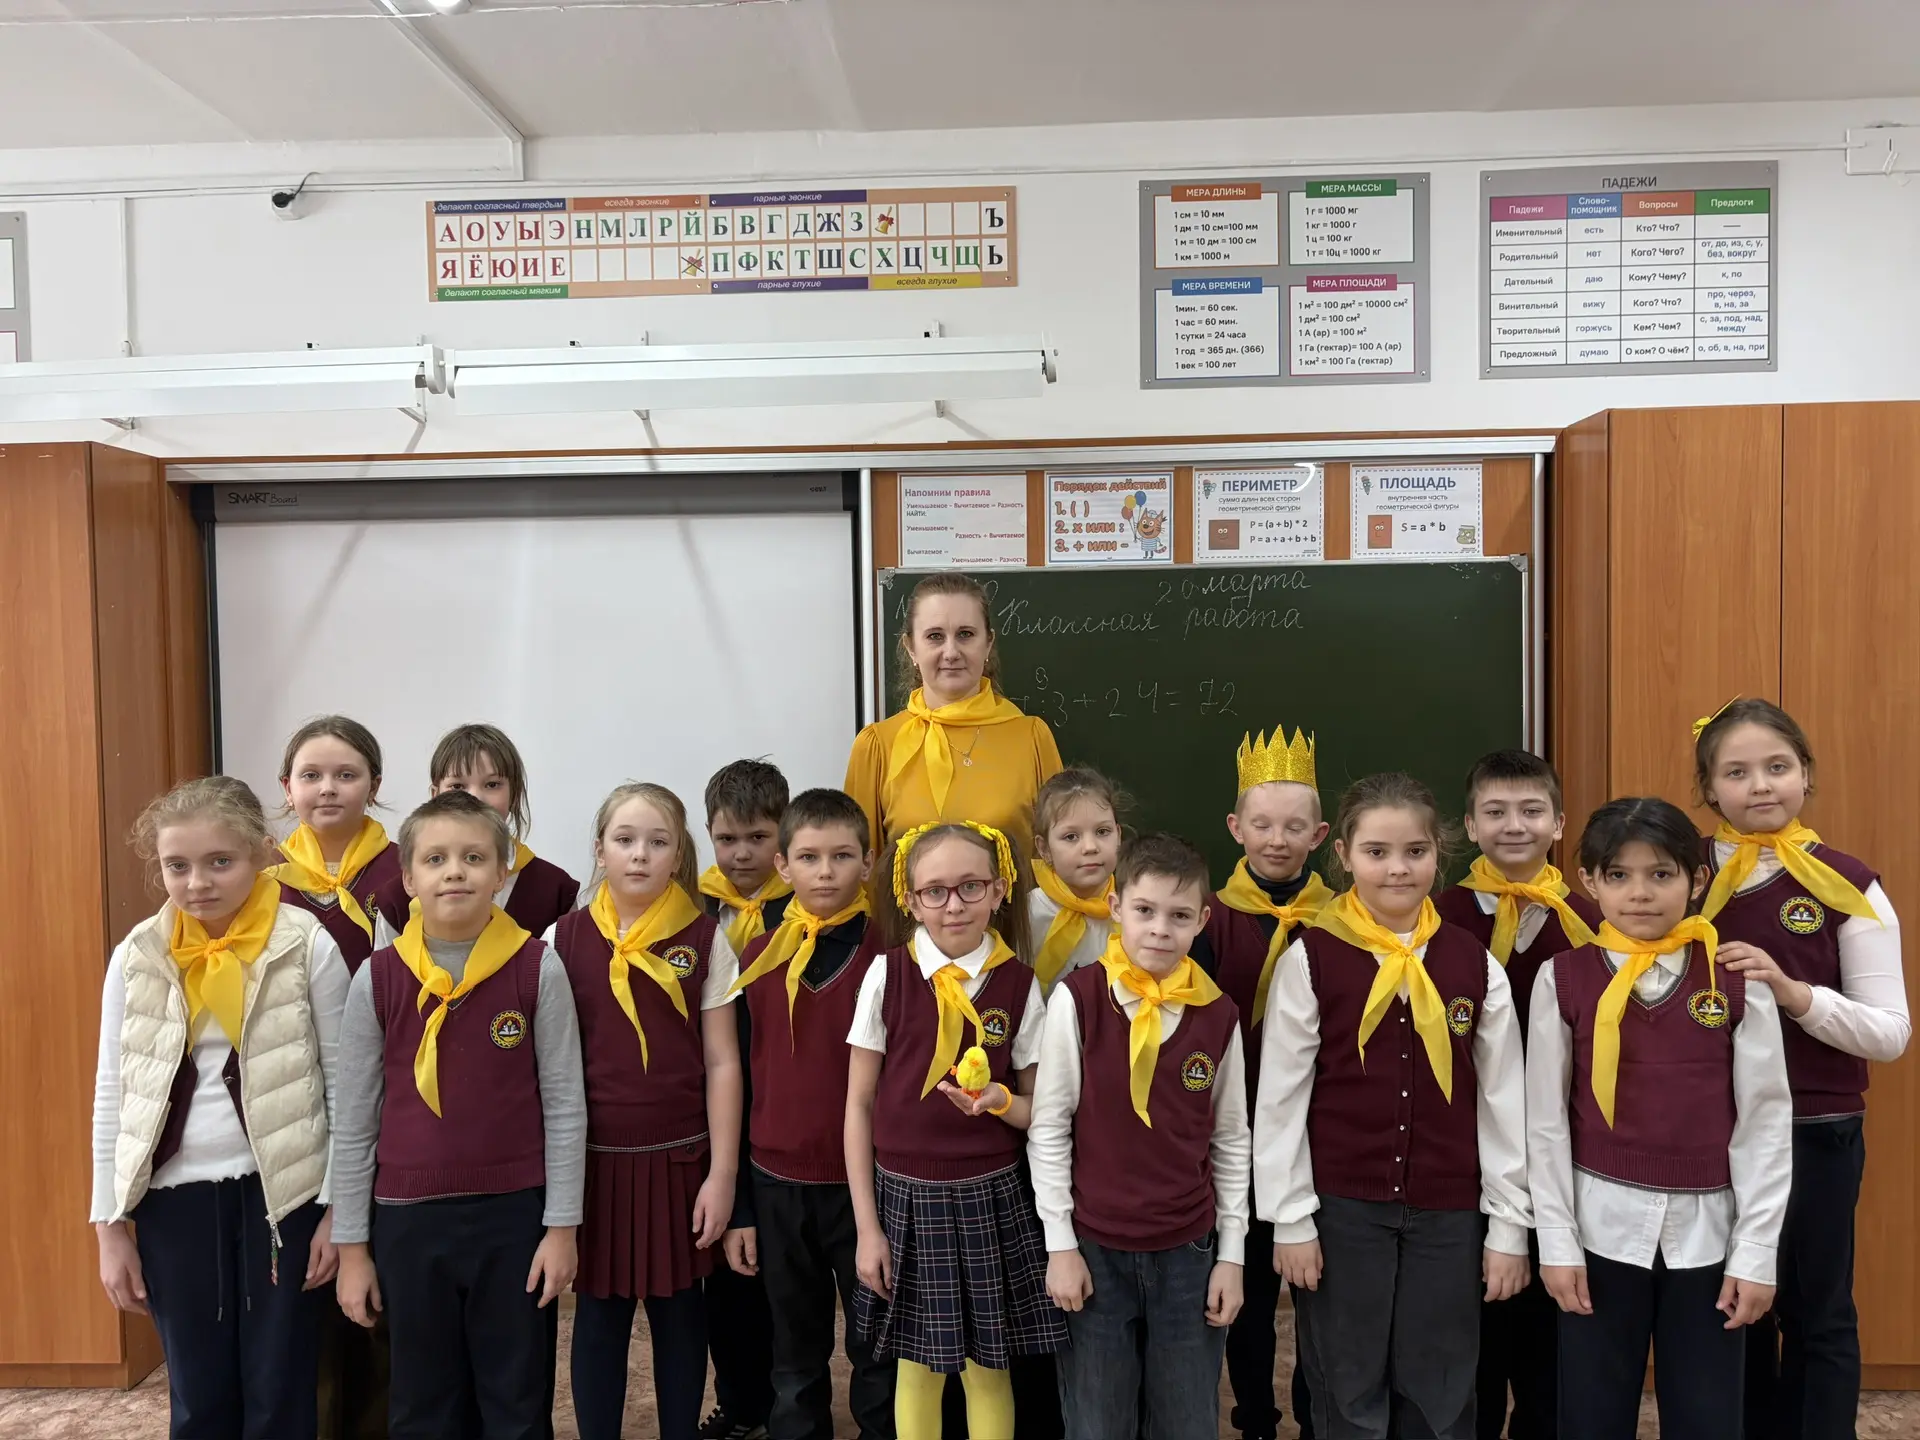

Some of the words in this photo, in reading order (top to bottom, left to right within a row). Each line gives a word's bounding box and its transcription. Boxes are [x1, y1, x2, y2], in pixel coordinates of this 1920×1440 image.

[1602, 176, 1657, 189] ПАДЕЖИ
[1186, 189, 1210, 197] МЕРА
[1212, 188, 1246, 197] ДЛИНЫ
[1321, 185, 1346, 193] МЕРА
[1348, 184, 1382, 193] МАССЫ
[753, 194, 786, 203] парные
[788, 193, 822, 202] звонкие
[437, 202, 472, 212] делают
[474, 201, 518, 211] согласный
[520, 200, 563, 211] твердым
[604, 199, 634, 208] всегда
[635, 198, 670, 206] звонкие
[1639, 201, 1678, 210] Вопросы
[1711, 199, 1754, 208] Предлоги
[1325, 206, 1346, 215] 1000
[1509, 205, 1544, 215] Падежи
[1571, 206, 1617, 214] помощник
[439, 223, 457, 242] А
[466, 221, 484, 242] О
[492, 221, 511, 241] У
[519, 221, 541, 241] Ы
[549, 220, 565, 240] Э
[574, 219, 593, 239] Н
[600, 218, 622, 238] М
[629, 218, 647, 238] Л
[659, 217, 673, 237] Р
[684, 211, 703, 236] Й
[712, 216, 728, 236] Б
[740, 215, 755, 235] В
[767, 214, 782, 234] Г
[793, 213, 811, 237] Д
[816, 213, 841, 232] Ж
[850, 212, 863, 232] З
[985, 208, 1004, 228] Ъ
[1330, 221, 1351, 229] 1000
[1659, 224, 1680, 232] Что?
[1495, 228, 1562, 237] Именительный
[1207, 239, 1219, 247] дм
[1201, 252, 1222, 260] 1000
[1350, 248, 1371, 256] 1000
[1372, 248, 1381, 256] кг
[1631, 248, 1657, 257] Кого?
[1659, 247, 1685, 256] Чего?
[1727, 250, 1757, 258] вокруг
[1500, 252, 1559, 262] Родительный
[441, 259, 457, 279] Я
[469, 254, 484, 278] Ё
[492, 258, 516, 278] Ю
[522, 258, 540, 277] И
[550, 257, 566, 277] Е
[711, 252, 731, 272] П
[737, 251, 758, 272] Ф
[767, 250, 784, 271] К
[794, 250, 811, 270] Т
[818, 249, 842, 269] Ш
[849, 248, 866, 268] С
[876, 247, 894, 268] Х
[903, 247, 922, 271] Ц
[932, 246, 949, 266] Ч
[955, 246, 980, 269] Щ
[987, 245, 1003, 265] Ь
[896, 277, 925, 287] всегда
[928, 277, 958, 286] глухие
[1504, 277, 1553, 287] Дательный
[1585, 276, 1603, 284] даю
[1629, 273, 1657, 283] Кому?
[1659, 272, 1687, 282] Чему?
[757, 280, 790, 290] парные
[792, 280, 821, 289] глухие
[1182, 282, 1207, 290] МЕРА
[1209, 281, 1251, 290] ВРЕМЕНИ
[1313, 280, 1338, 288] МЕРА
[1339, 278, 1387, 288] ПЛОЩАДИ
[445, 288, 480, 297] делают
[482, 288, 527, 297] согласный
[529, 286, 561, 295] мягким
[1365, 300, 1392, 308] 10000
[1499, 302, 1558, 311] Винительный
[1583, 301, 1605, 309] вижу
[1633, 299, 1659, 307] Кого?
[1661, 298, 1682, 306] Что?
[1207, 304, 1219, 312] 60
[1205, 318, 1217, 326] 60
[1313, 329, 1330, 338] (ар)
[1340, 328, 1355, 336] 100
[1497, 326, 1560, 336] Творительный
[1576, 325, 1612, 333] горжусь
[1717, 325, 1746, 333] между
[1181, 334, 1205, 342] сутки
[1181, 348, 1196, 356] год
[1207, 346, 1224, 354] 365
[1225, 347, 1239, 355] дн.
[1241, 345, 1265, 355] (366)
[1385, 343, 1402, 352] (ар)
[1635, 347, 1657, 355] ком?
[1668, 346, 1689, 354] чём?
[1500, 349, 1557, 359] Предложный
[1580, 349, 1609, 358] думаю
[1358, 357, 1393, 366] (гектар)
[1054, 481, 1107, 494] Порядок
[1109, 478, 1167, 492] действий
[1222, 479, 1298, 492] ПЕРИМЕТР
[1380, 477, 1456, 490] ПЛОЩАДЬ
[905, 489, 951, 497] Напомним
[954, 489, 991, 497] правила
[228, 492, 270, 504] SMART
[1219, 505, 1274, 513] геометрической
[1376, 503, 1432, 511] геометрической
[1433, 503, 1459, 511] фигуры
[1201, 570, 1312, 607] марта
[1184, 595, 1304, 641] работа
